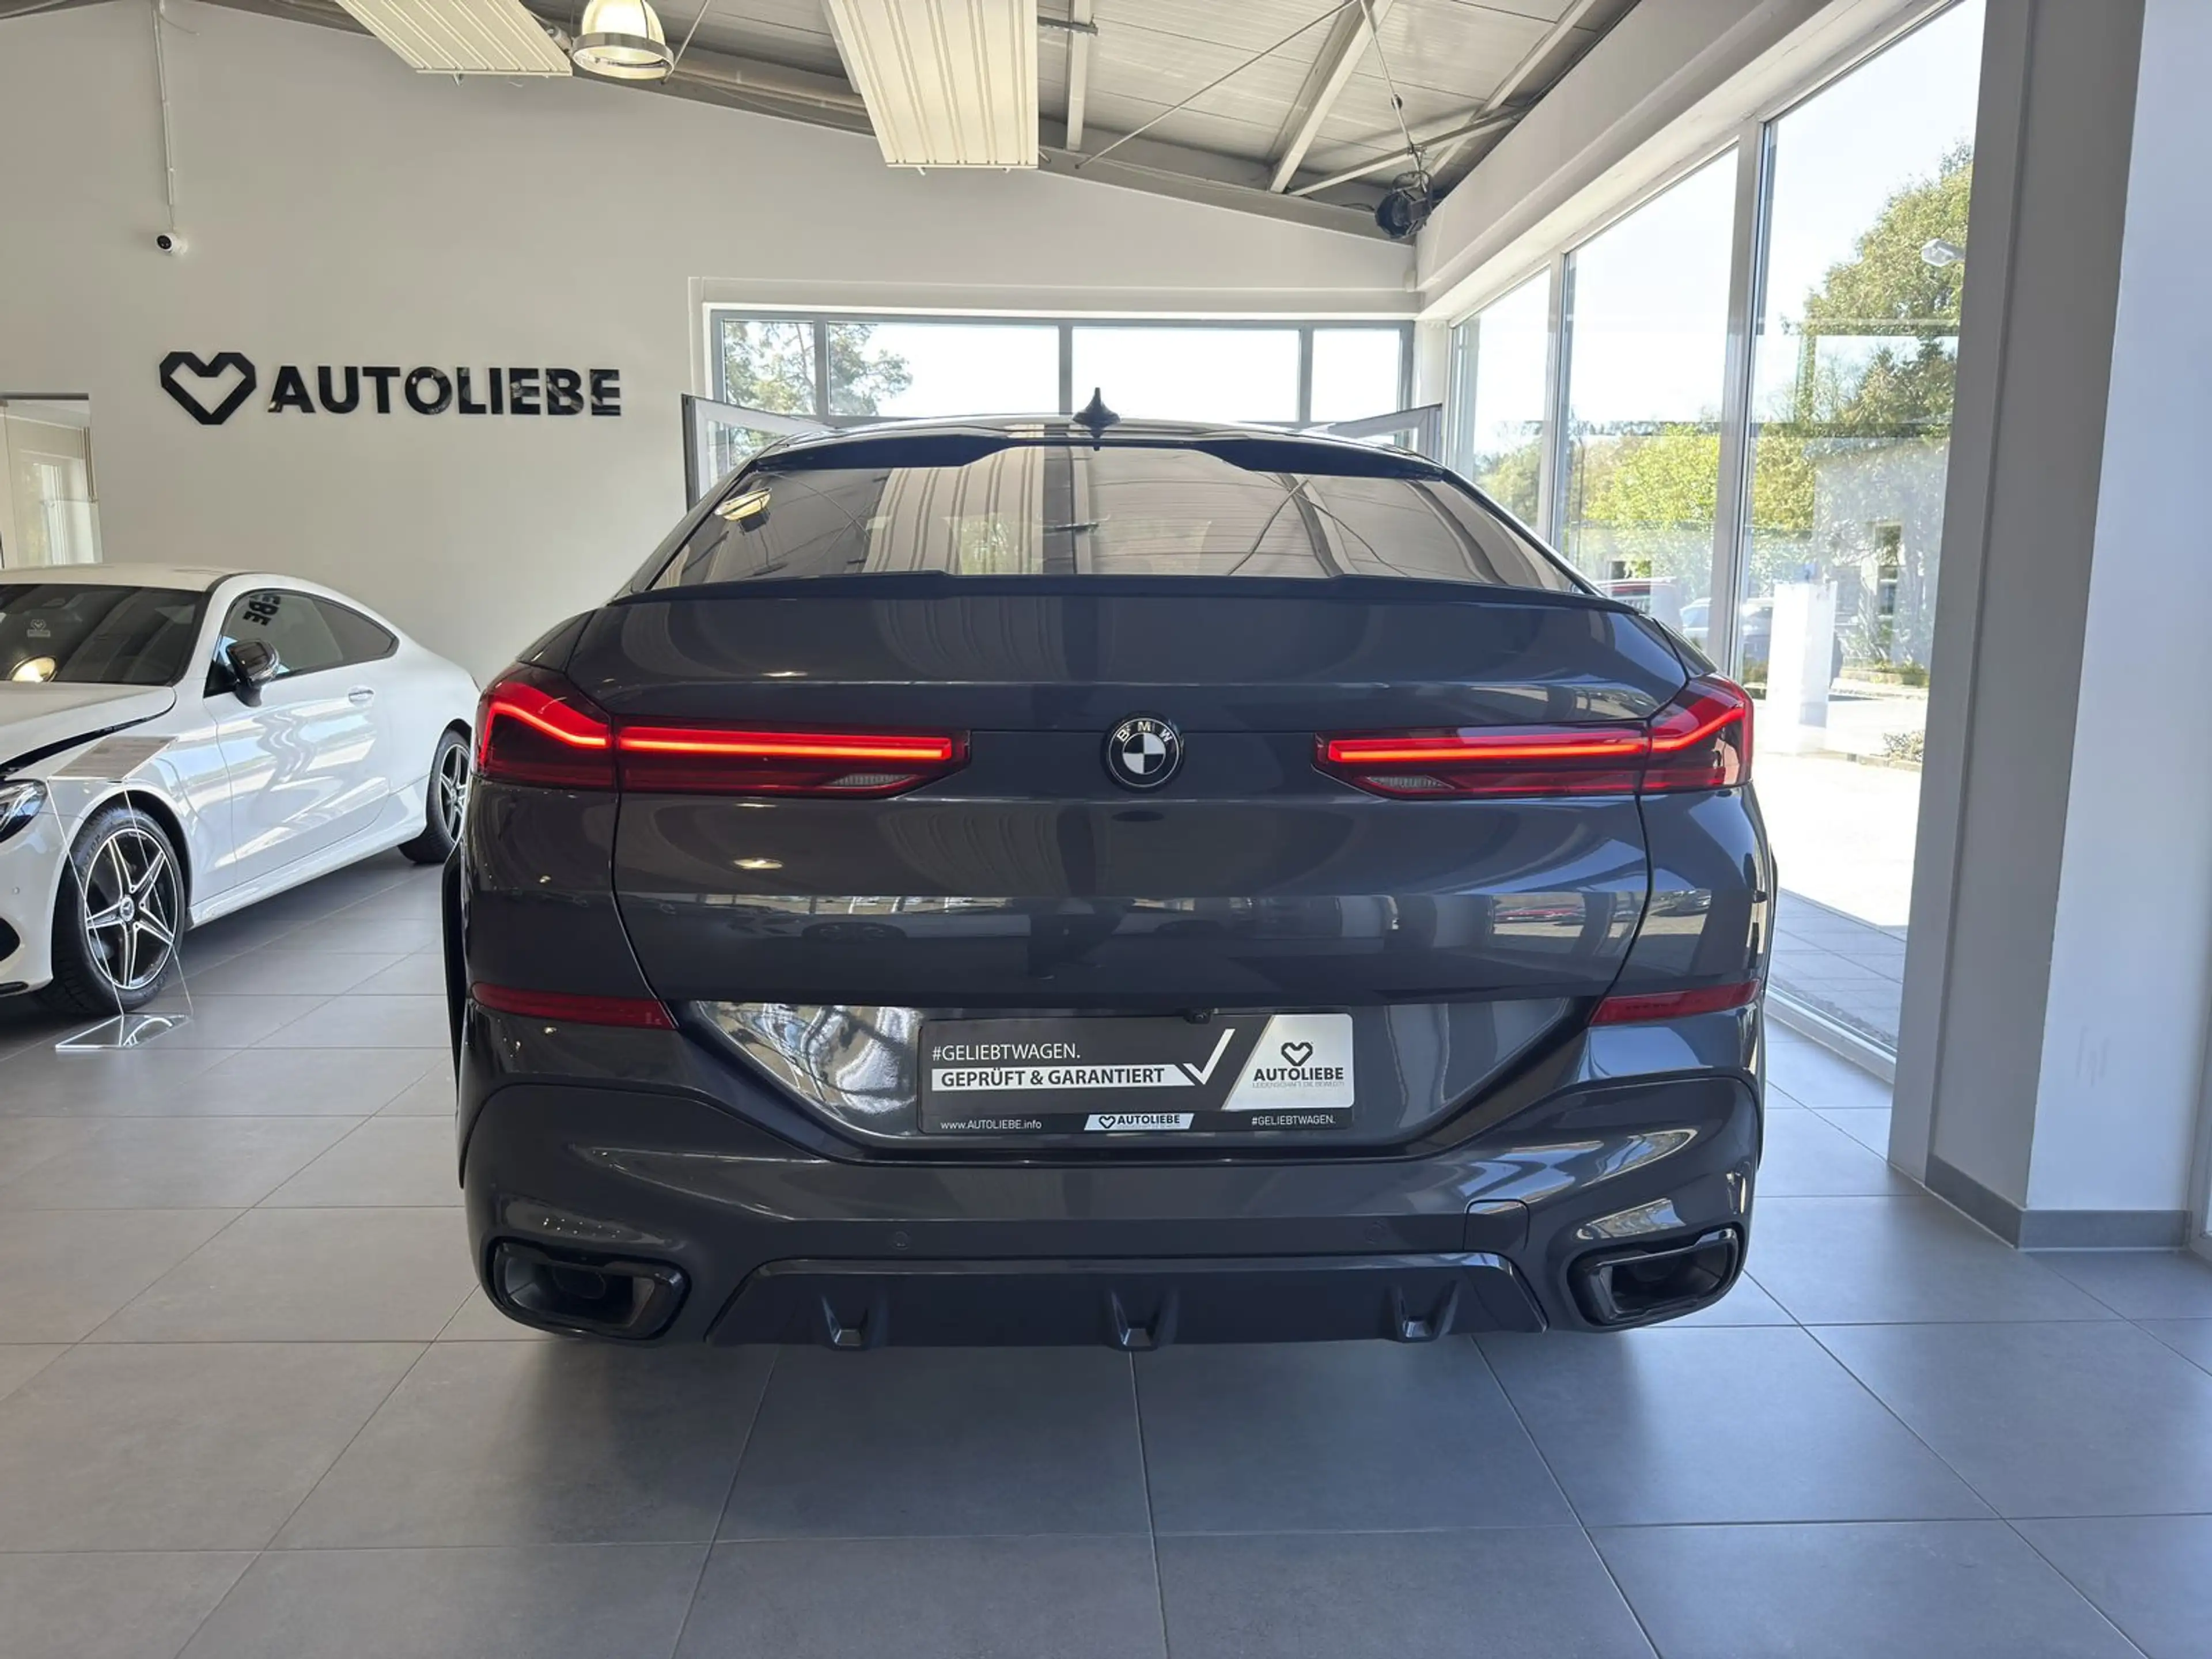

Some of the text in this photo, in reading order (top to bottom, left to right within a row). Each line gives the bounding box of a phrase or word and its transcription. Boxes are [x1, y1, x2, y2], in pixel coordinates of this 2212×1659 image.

[267, 365, 622, 416] AUTOLIEBE
[1116, 721, 1173, 743] BMW
[932, 1043, 1081, 1061] #GELIEBTWAGEN.
[941, 1067, 1165, 1086] GEPRÜFT & GARANTIERT
[1253, 1067, 1344, 1081] AUTOLIEBE
[941, 1119, 1042, 1130] www.AUTOLIEBE.info
[1117, 1115, 1180, 1125] AUTOLIEBE
[1251, 1114, 1336, 1126] #GELIEBTWAGEN.
